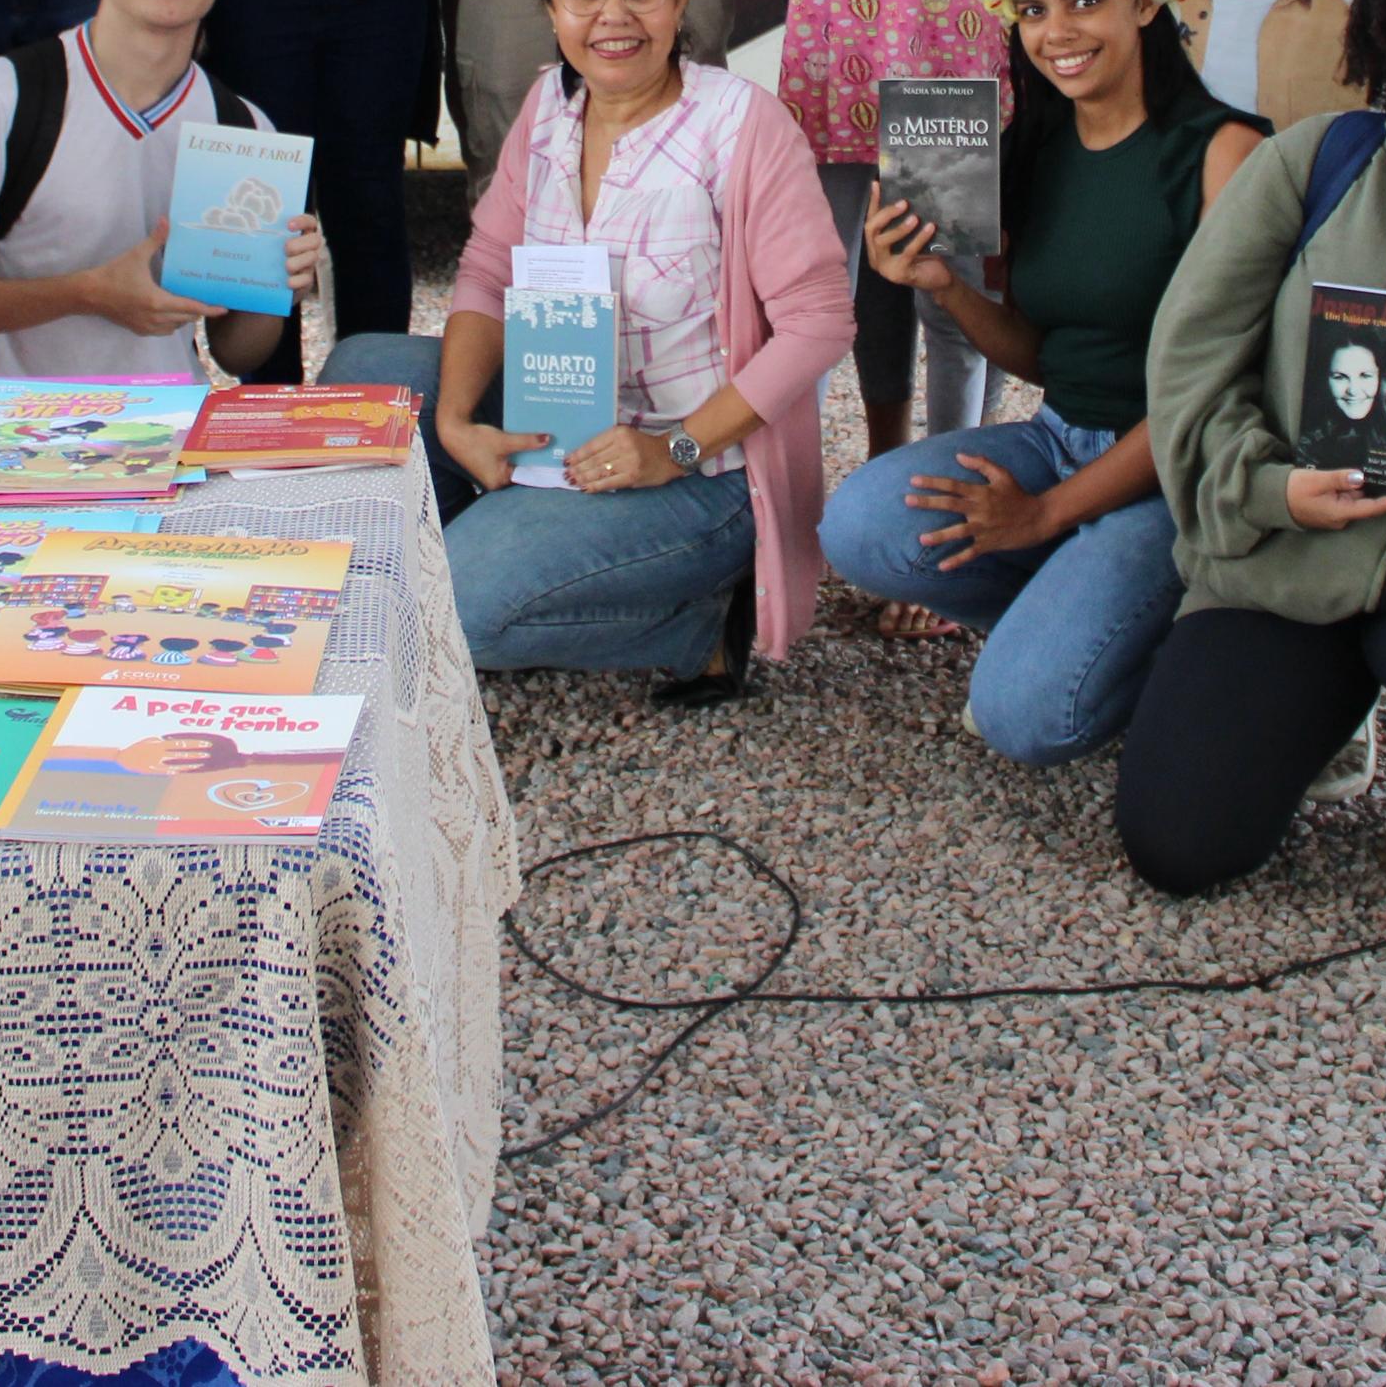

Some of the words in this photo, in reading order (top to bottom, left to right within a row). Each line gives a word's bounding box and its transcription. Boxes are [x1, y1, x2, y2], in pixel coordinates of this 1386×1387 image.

[931, 86, 946, 95] SÃO
[948, 87, 974, 96] PAULO
[889, 123, 901, 135] O
[904, 116, 989, 135] MISTÉRIO
[188, 135, 233, 154] LUZES
[235, 143, 253, 157] DE
[259, 146, 304, 164] FAROL
[889, 136, 903, 146] DA
[906, 135, 937, 147] CASA
[938, 136, 953, 147] NA
[956, 135, 989, 147] PRAIA
[523, 353, 596, 373] QUARTO
[524, 375, 536, 384] de
[539, 373, 595, 387] DESPEJO
[123, 670, 181, 681] COGITO
[112, 696, 138, 711] A
[147, 699, 217, 716] pele
[227, 704, 283, 717] que
[179, 716, 214, 726] eu
[220, 715, 319, 733] tenho
